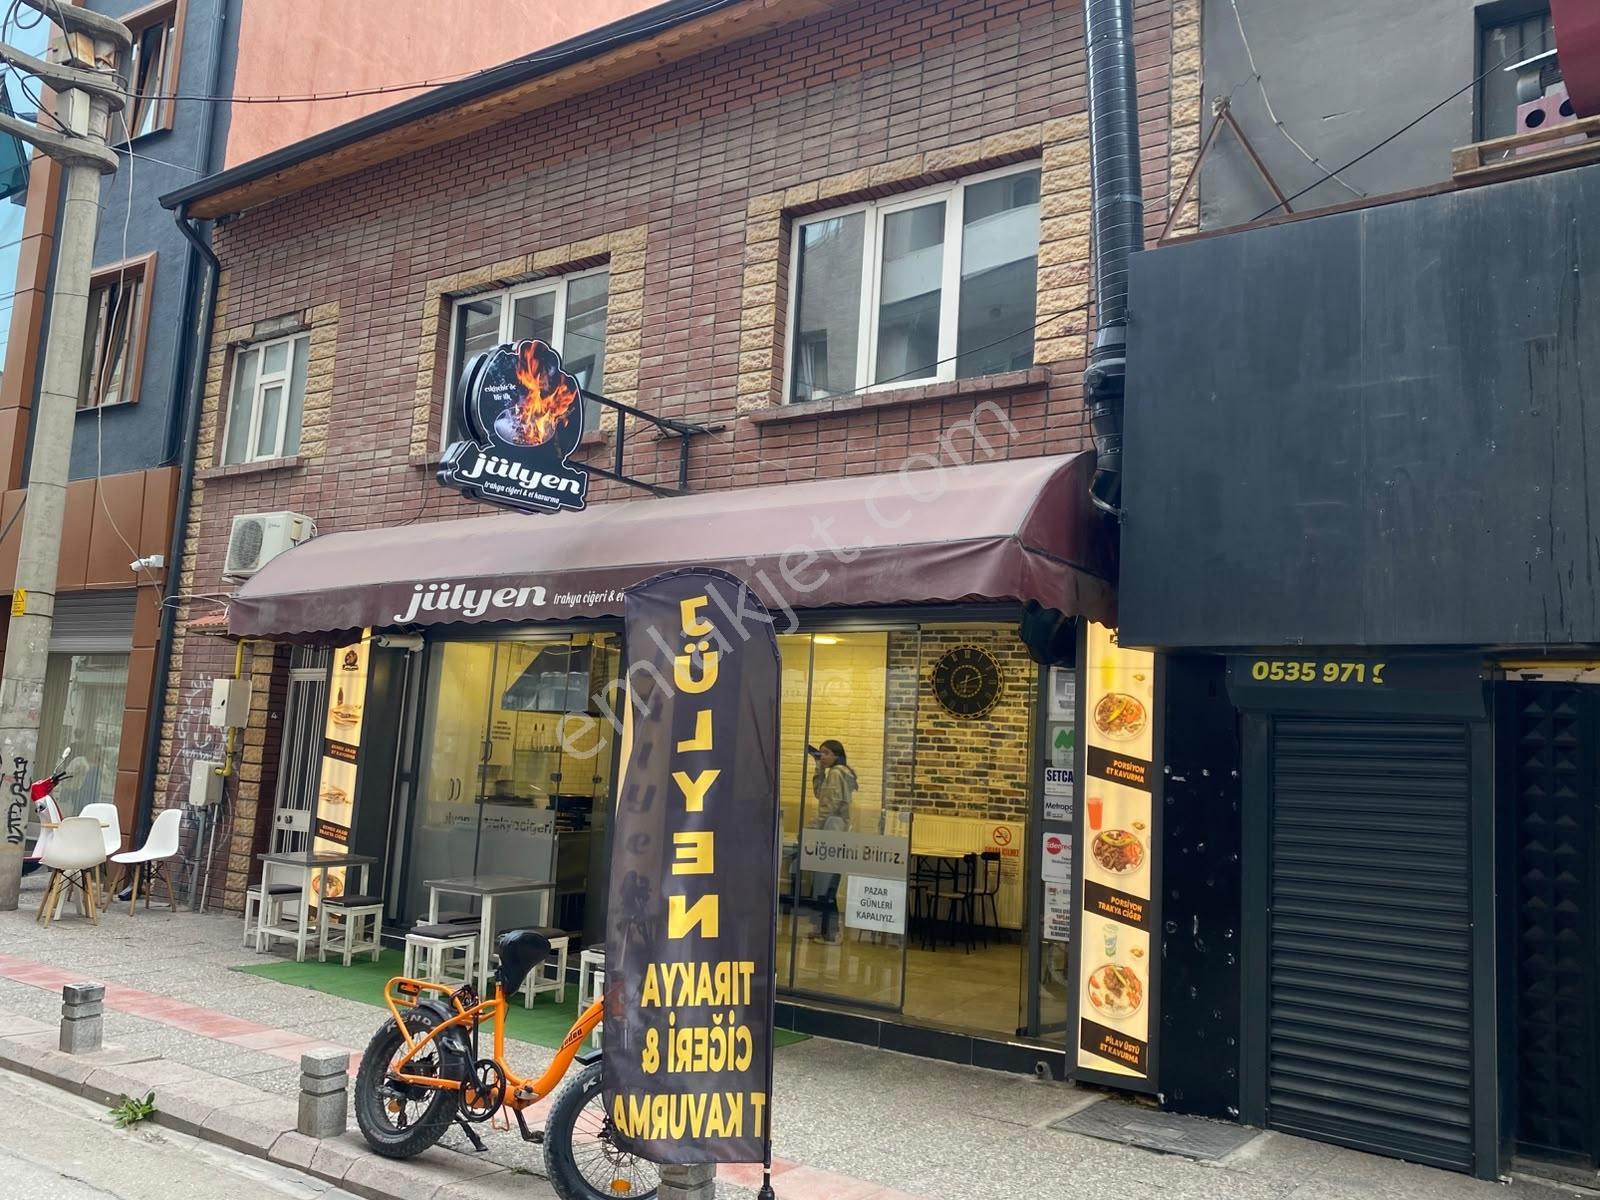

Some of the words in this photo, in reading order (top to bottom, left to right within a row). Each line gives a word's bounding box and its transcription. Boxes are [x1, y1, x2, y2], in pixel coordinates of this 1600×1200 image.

[461, 453, 580, 495] jülyen
[393, 582, 547, 624] jülyen
[553, 592, 582, 608] trakya
[582, 589, 608, 607] ciğeri
[608, 589, 616, 602] &
[1252, 661, 1317, 682] 0535
[1323, 662, 1365, 683] 971
[864, 886, 889, 896] PAZAR
[860, 897, 892, 910] GÜNLERİ
[1098, 901, 1122, 915] TRAKYA
